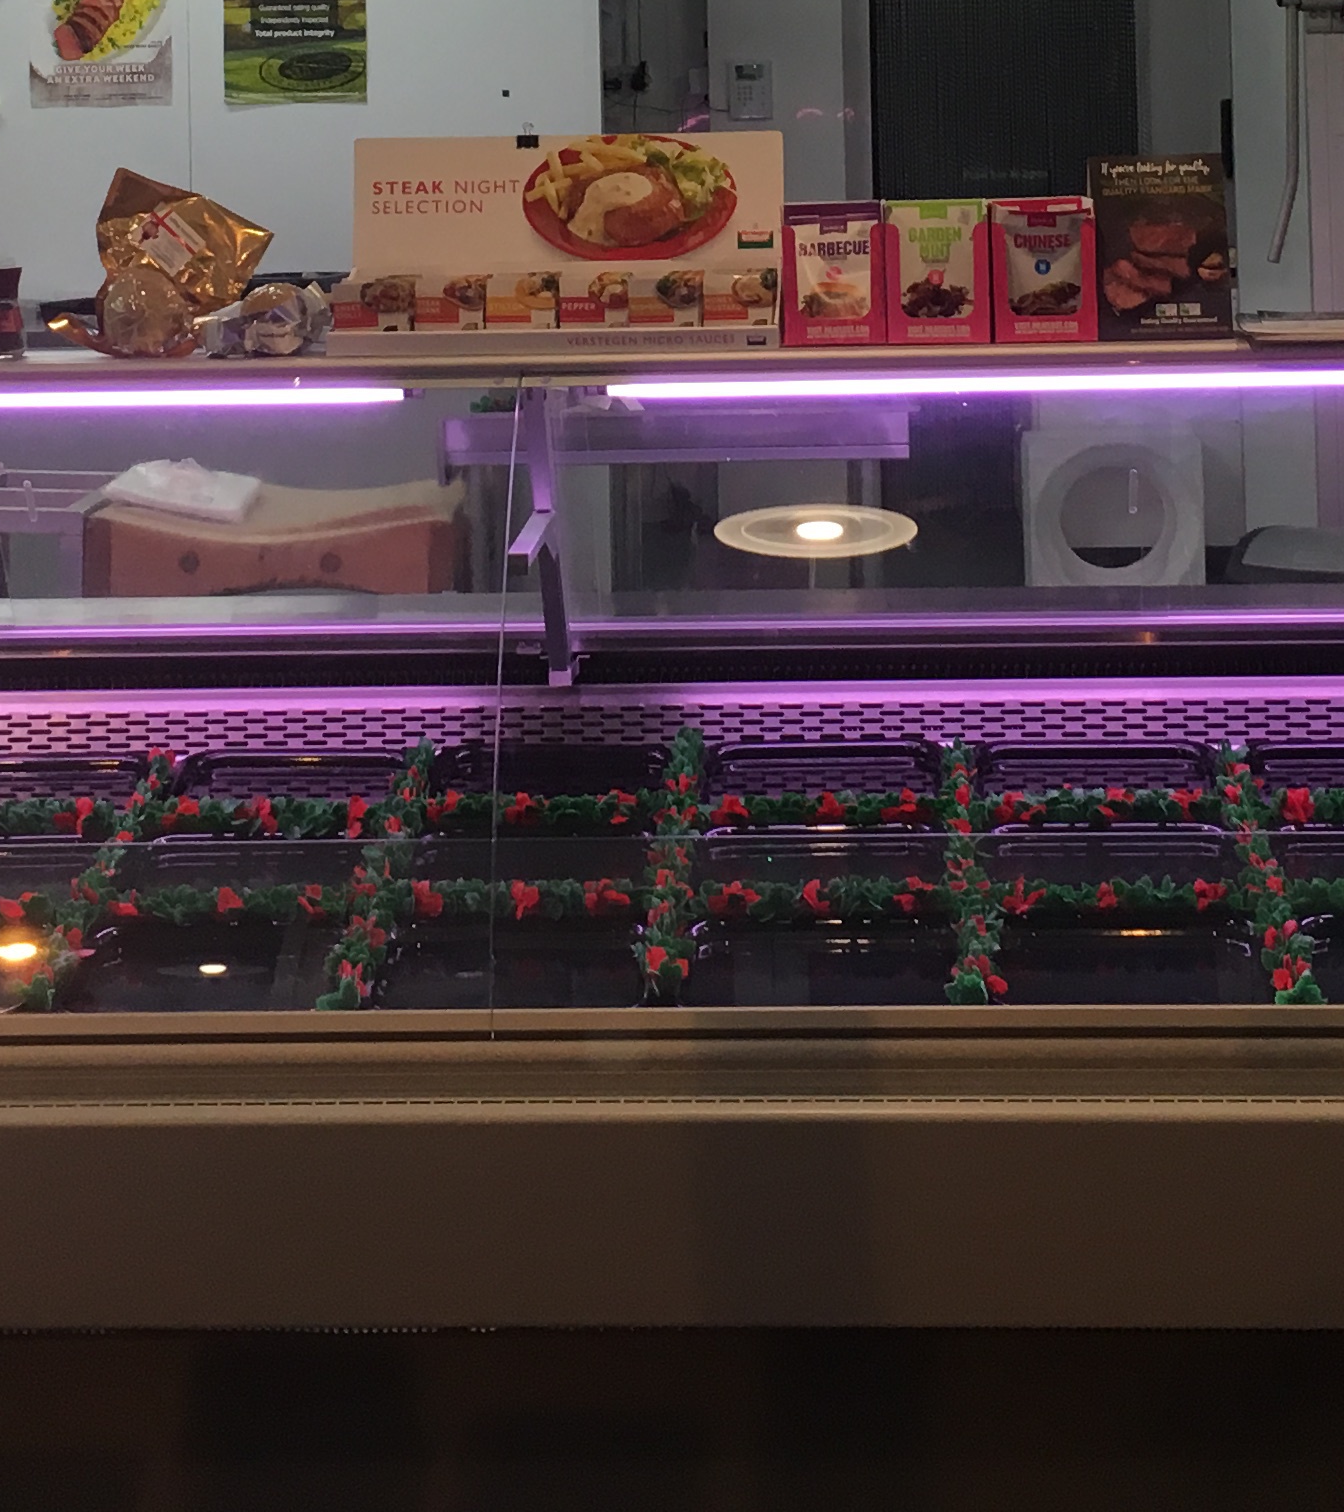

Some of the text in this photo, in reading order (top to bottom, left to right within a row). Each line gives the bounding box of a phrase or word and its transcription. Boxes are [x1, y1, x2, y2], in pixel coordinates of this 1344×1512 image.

[56, 64, 145, 74] GIVE YOUR WEEK
[65, 74, 100, 84] EXTRA
[103, 74, 155, 83] WEEKEND
[372, 179, 520, 196] STEAK NIGHT
[371, 199, 484, 215] SELECTION
[908, 226, 962, 242] GARDEN
[1013, 233, 1071, 250] CHINESE
[798, 239, 870, 257] BARBECUE
[920, 243, 952, 259] MINT
[561, 302, 596, 311] PEPPER
[567, 334, 736, 346] VERSTEGEN MICRO SAUCES
